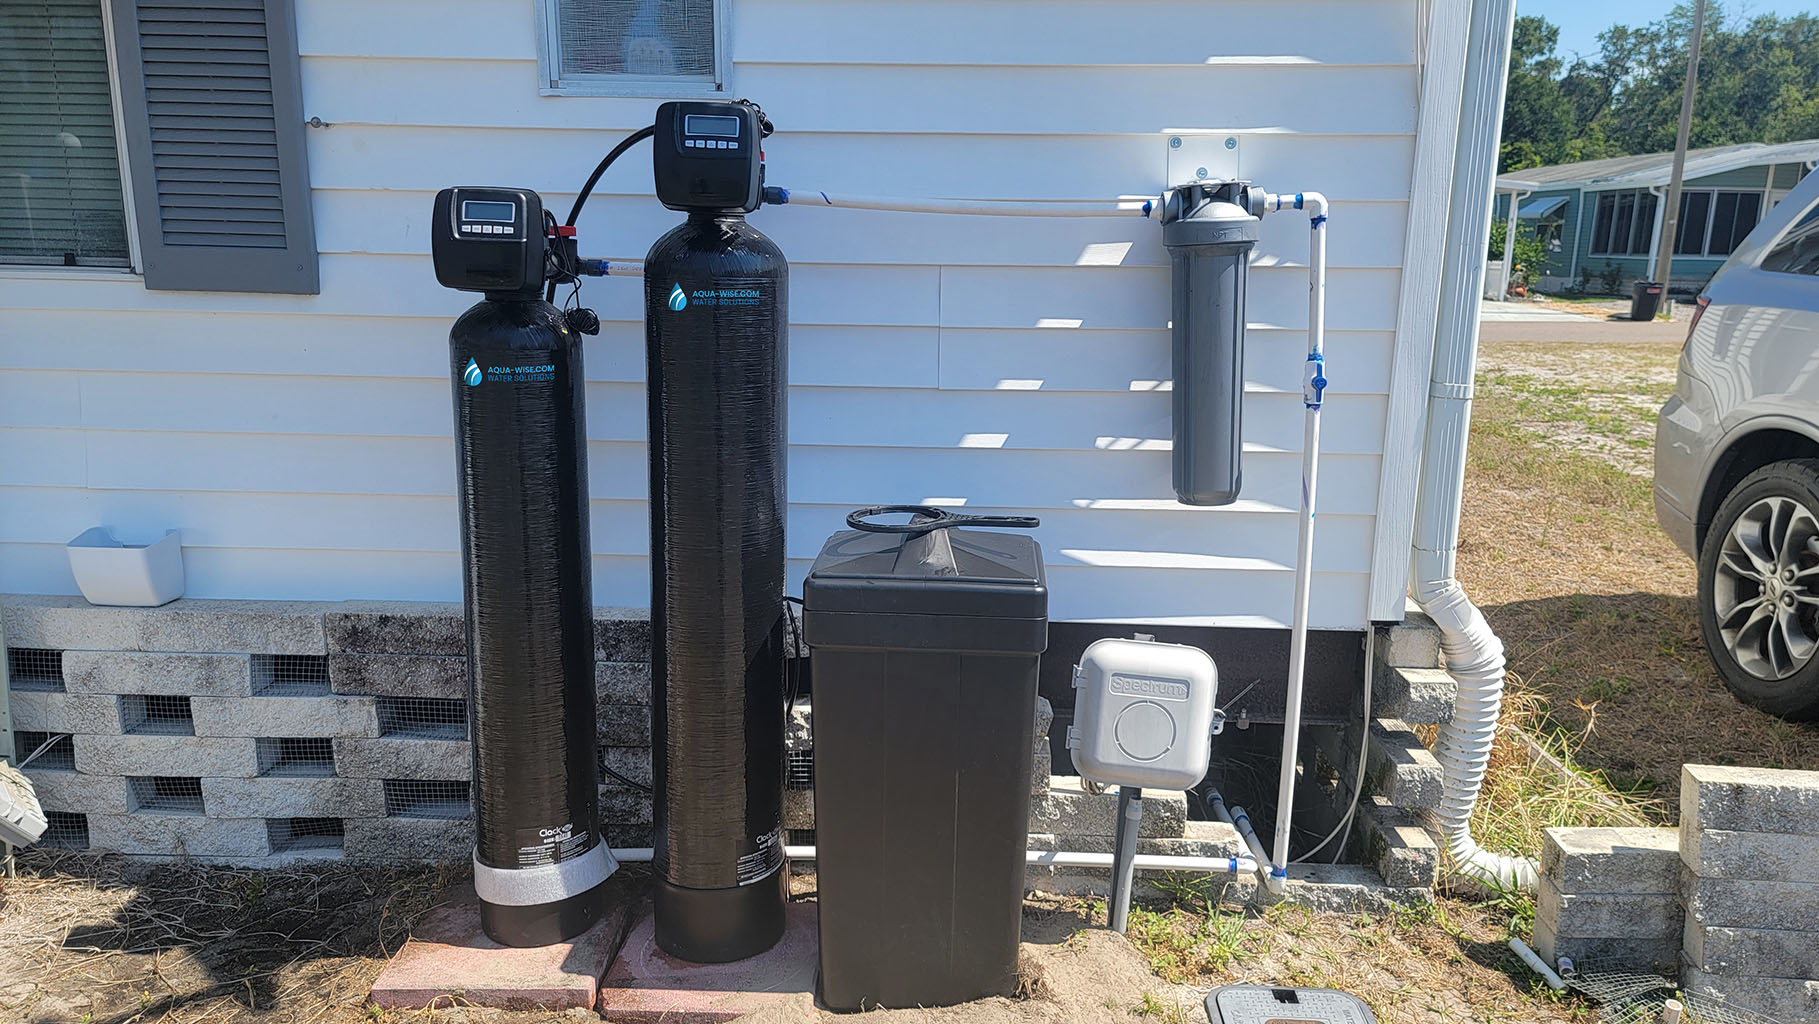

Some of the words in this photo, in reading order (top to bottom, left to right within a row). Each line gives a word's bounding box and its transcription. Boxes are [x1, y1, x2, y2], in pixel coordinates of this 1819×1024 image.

[692, 289, 760, 299] AQUA-WISE.COM
[692, 298, 717, 306] WATER
[719, 298, 760, 306] SOLUTIONS
[487, 364, 555, 375] AQUA-WISE.COM
[487, 374, 512, 383] WATER
[514, 373, 555, 382] SOLUTIONS
[1111, 677, 1181, 696] Spectrum
